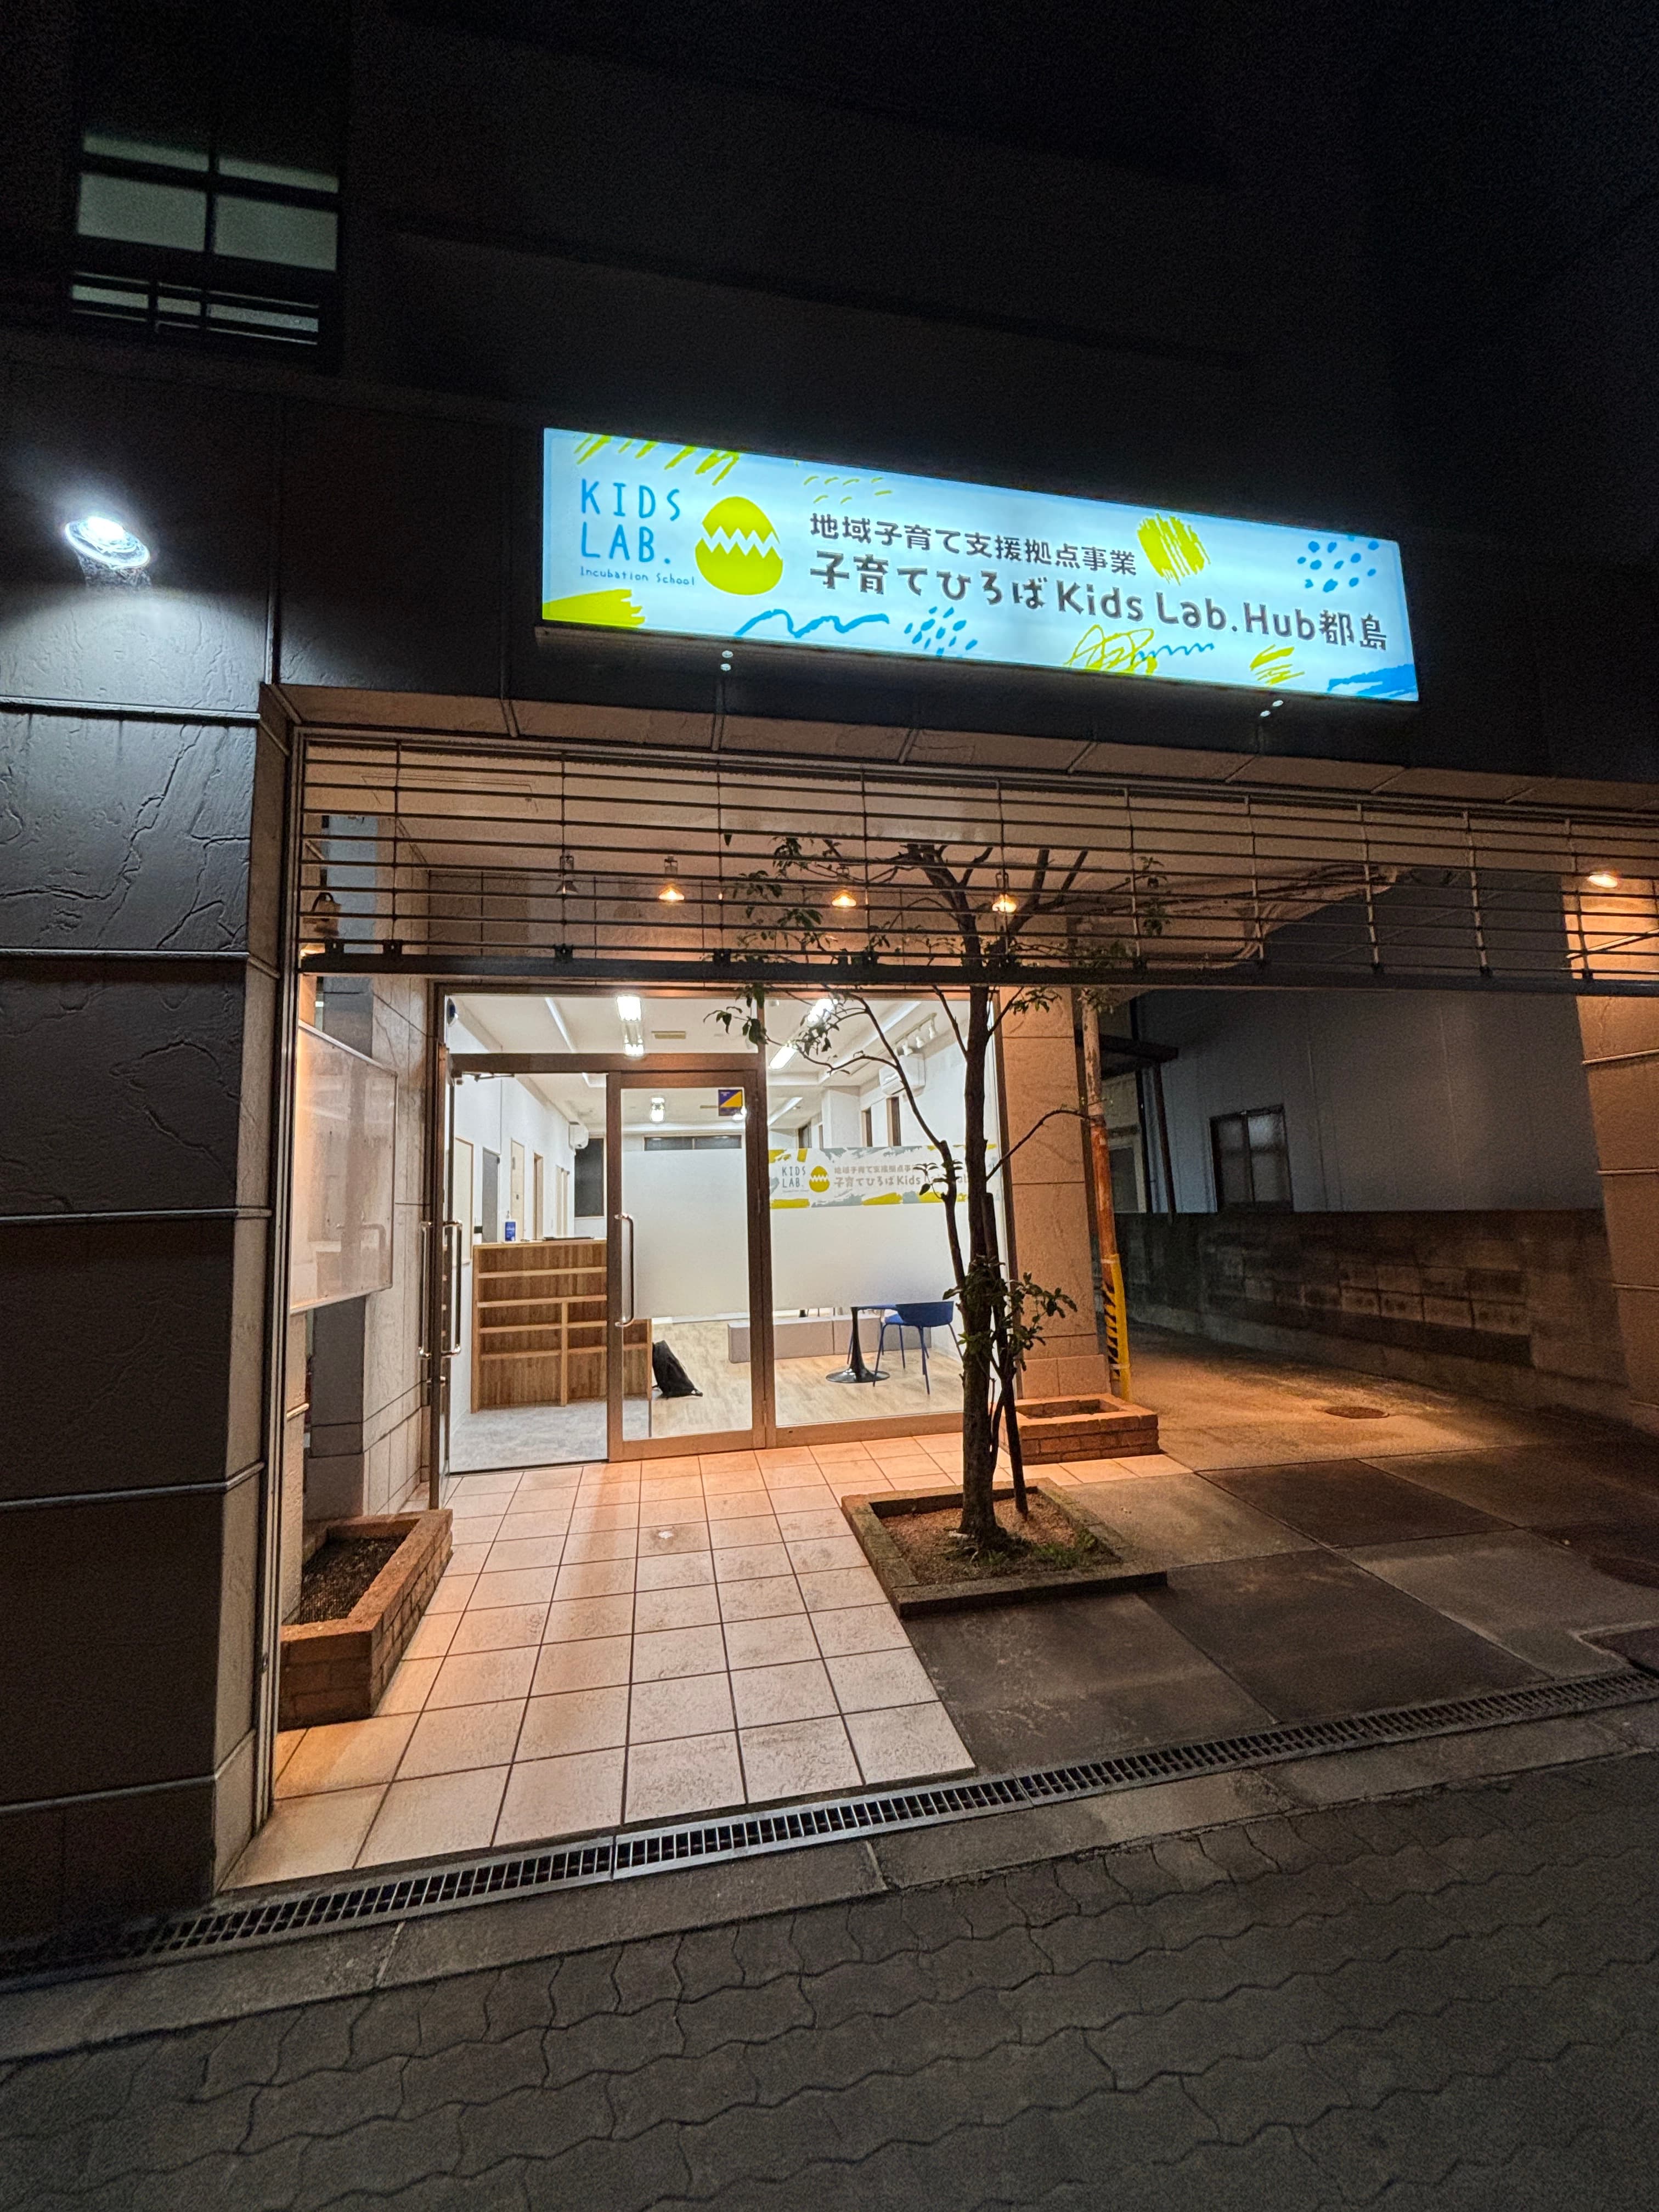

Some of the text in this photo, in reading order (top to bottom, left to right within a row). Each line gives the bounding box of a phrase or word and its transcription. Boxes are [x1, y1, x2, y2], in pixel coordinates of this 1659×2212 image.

[581, 478, 681, 522] KIDS
[581, 521, 672, 564] LAB.
[810, 513, 1137, 575] 地域子育て支援拠点事業
[580, 566, 695, 586] Incubation School
[782, 1166, 806, 1176] KIDS
